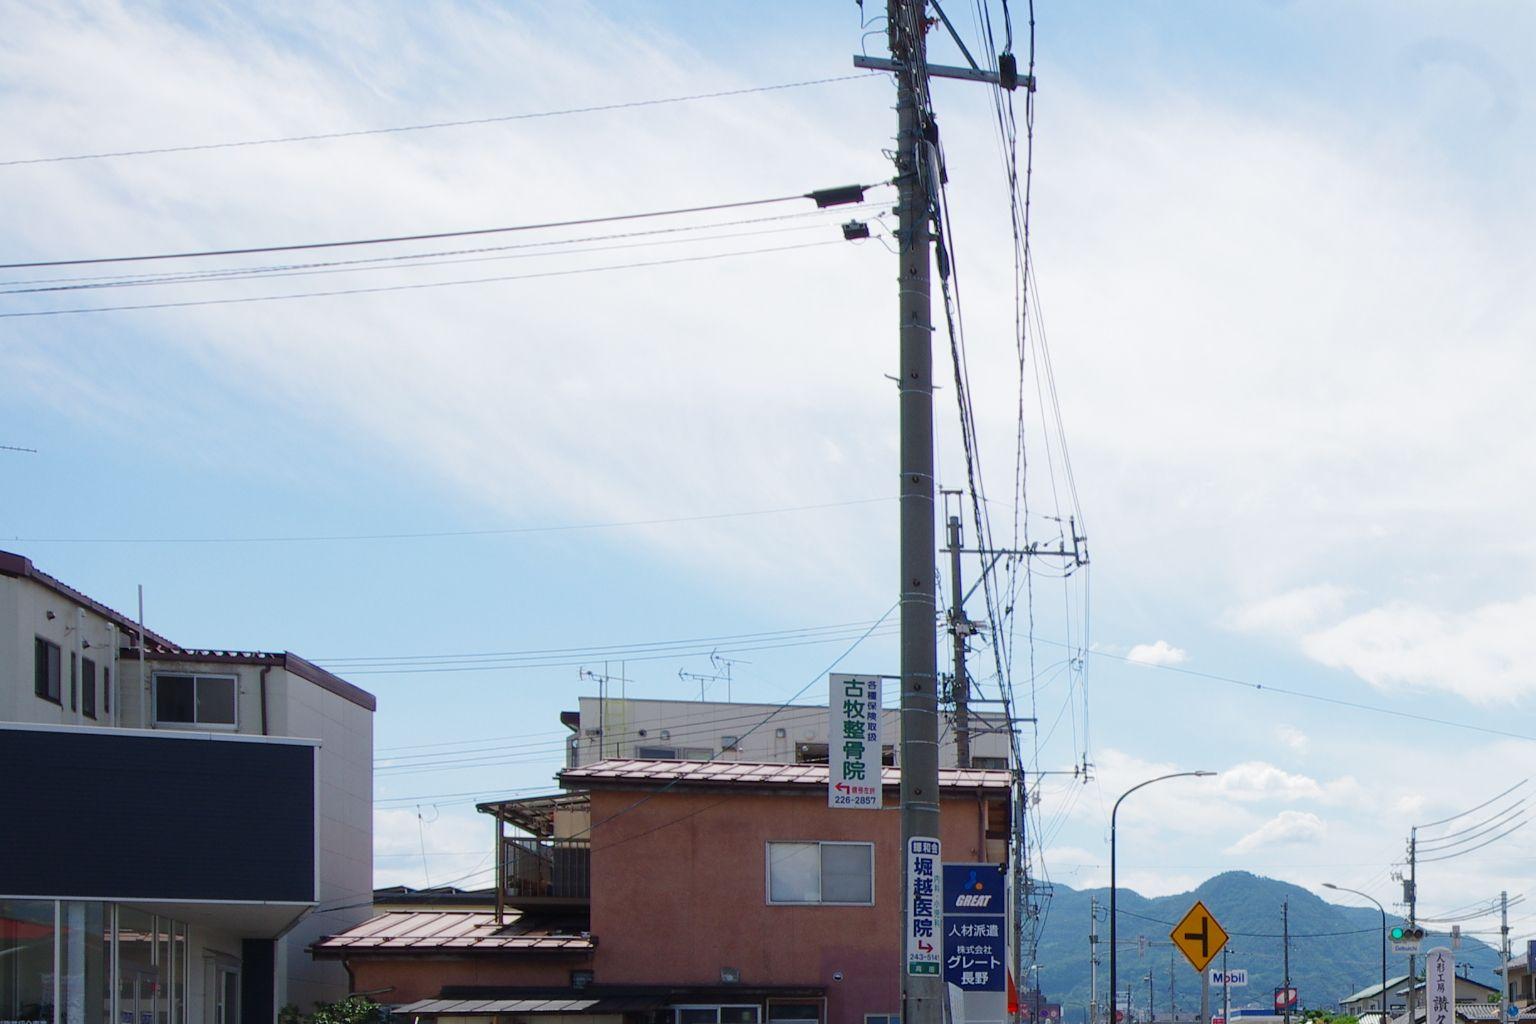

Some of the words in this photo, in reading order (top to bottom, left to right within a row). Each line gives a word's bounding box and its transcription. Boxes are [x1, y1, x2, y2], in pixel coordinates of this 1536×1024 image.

[843, 678, 866, 780] 古牧整骨院
[834, 796, 876, 805] 226-2857
[913, 857, 933, 938] 堀越医院
[955, 894, 992, 908] GREAT
[948, 924, 999, 938] 人材派遣
[956, 945, 993, 955] 株式会社
[947, 956, 1001, 970] グレート
[961, 971, 989, 985] 長野
[1213, 973, 1245, 983] Mobil
